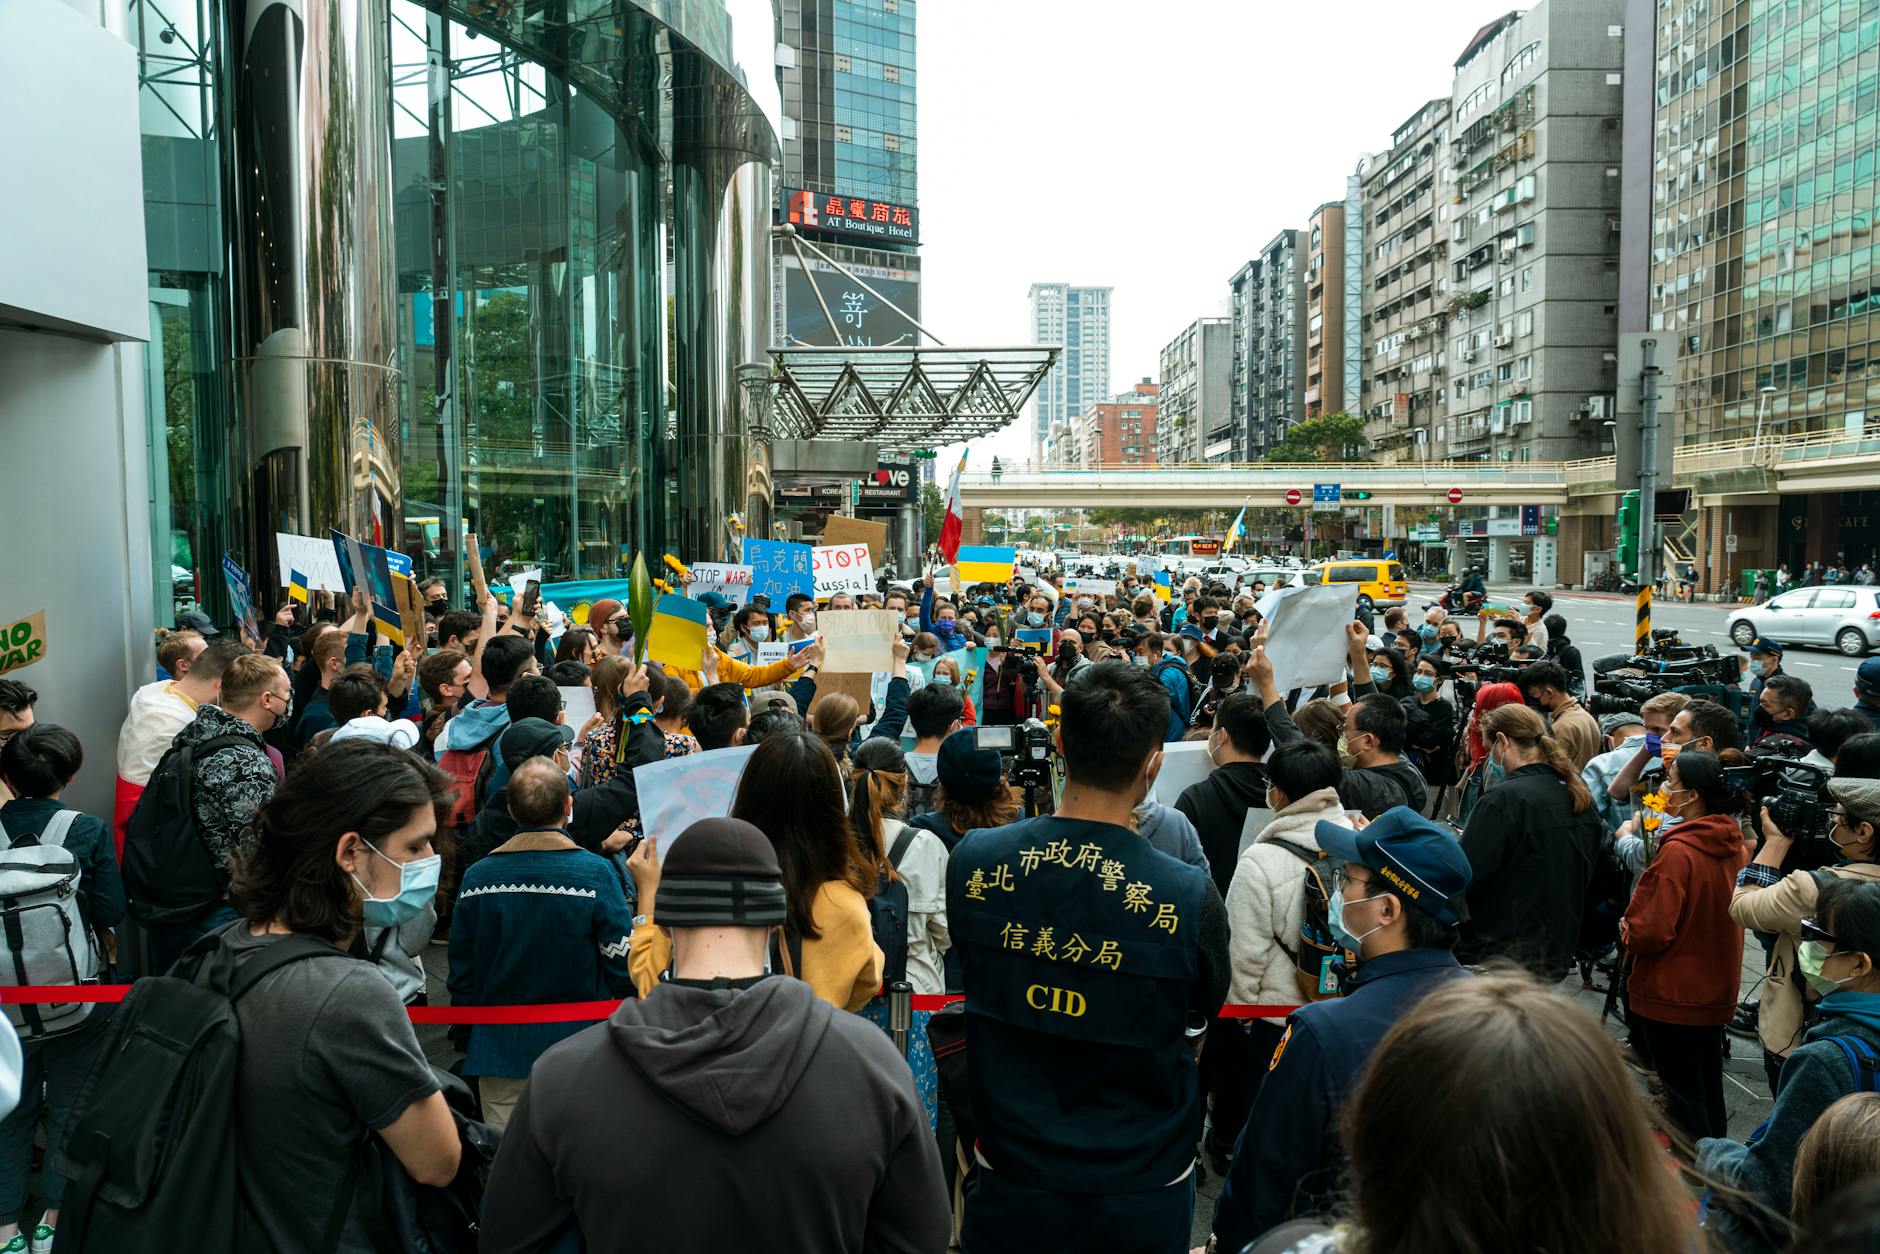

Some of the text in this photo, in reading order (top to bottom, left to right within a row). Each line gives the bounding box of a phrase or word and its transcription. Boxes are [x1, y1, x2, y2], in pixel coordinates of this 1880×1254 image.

[827, 217, 912, 238] AT Boutique Hotel
[692, 568, 747, 585] STOP WAR
[712, 584, 725, 592] IN
[762, 577, 801, 595] 加油
[0, 639, 42, 672] AR
[965, 838, 1179, 935] 臺北市政府警察局
[1000, 921, 1124, 971] 信義分局
[1026, 983, 1087, 1017] CID
